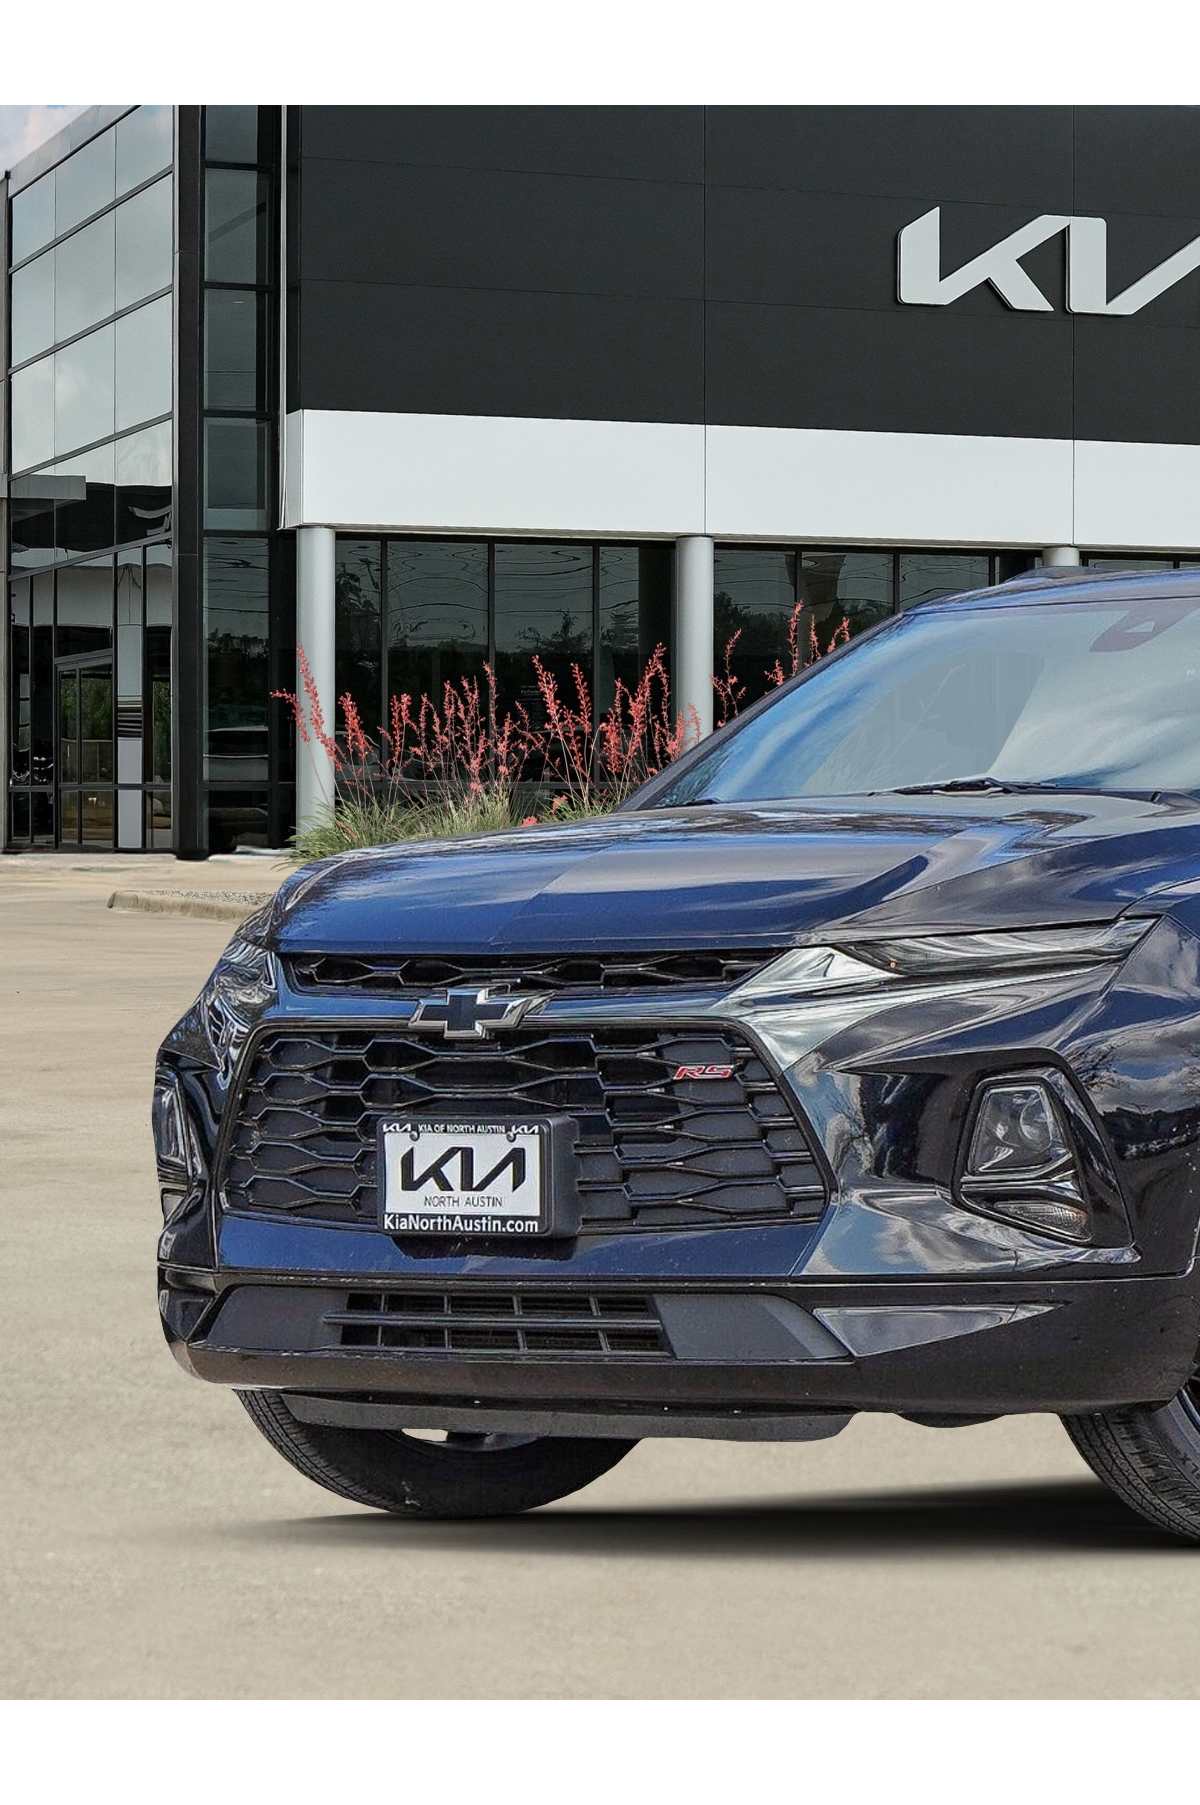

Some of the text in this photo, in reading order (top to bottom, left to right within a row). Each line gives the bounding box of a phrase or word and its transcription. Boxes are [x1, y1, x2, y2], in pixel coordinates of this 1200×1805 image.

[673, 1065, 735, 1080] RS
[382, 1123, 539, 1134] KIA KIA OF NORTH AUSTIN KIA
[400, 1146, 526, 1193] KIA
[424, 1196, 503, 1208] NORTH AUSTIN
[383, 1214, 539, 1233] KiaNorthAustin.com
